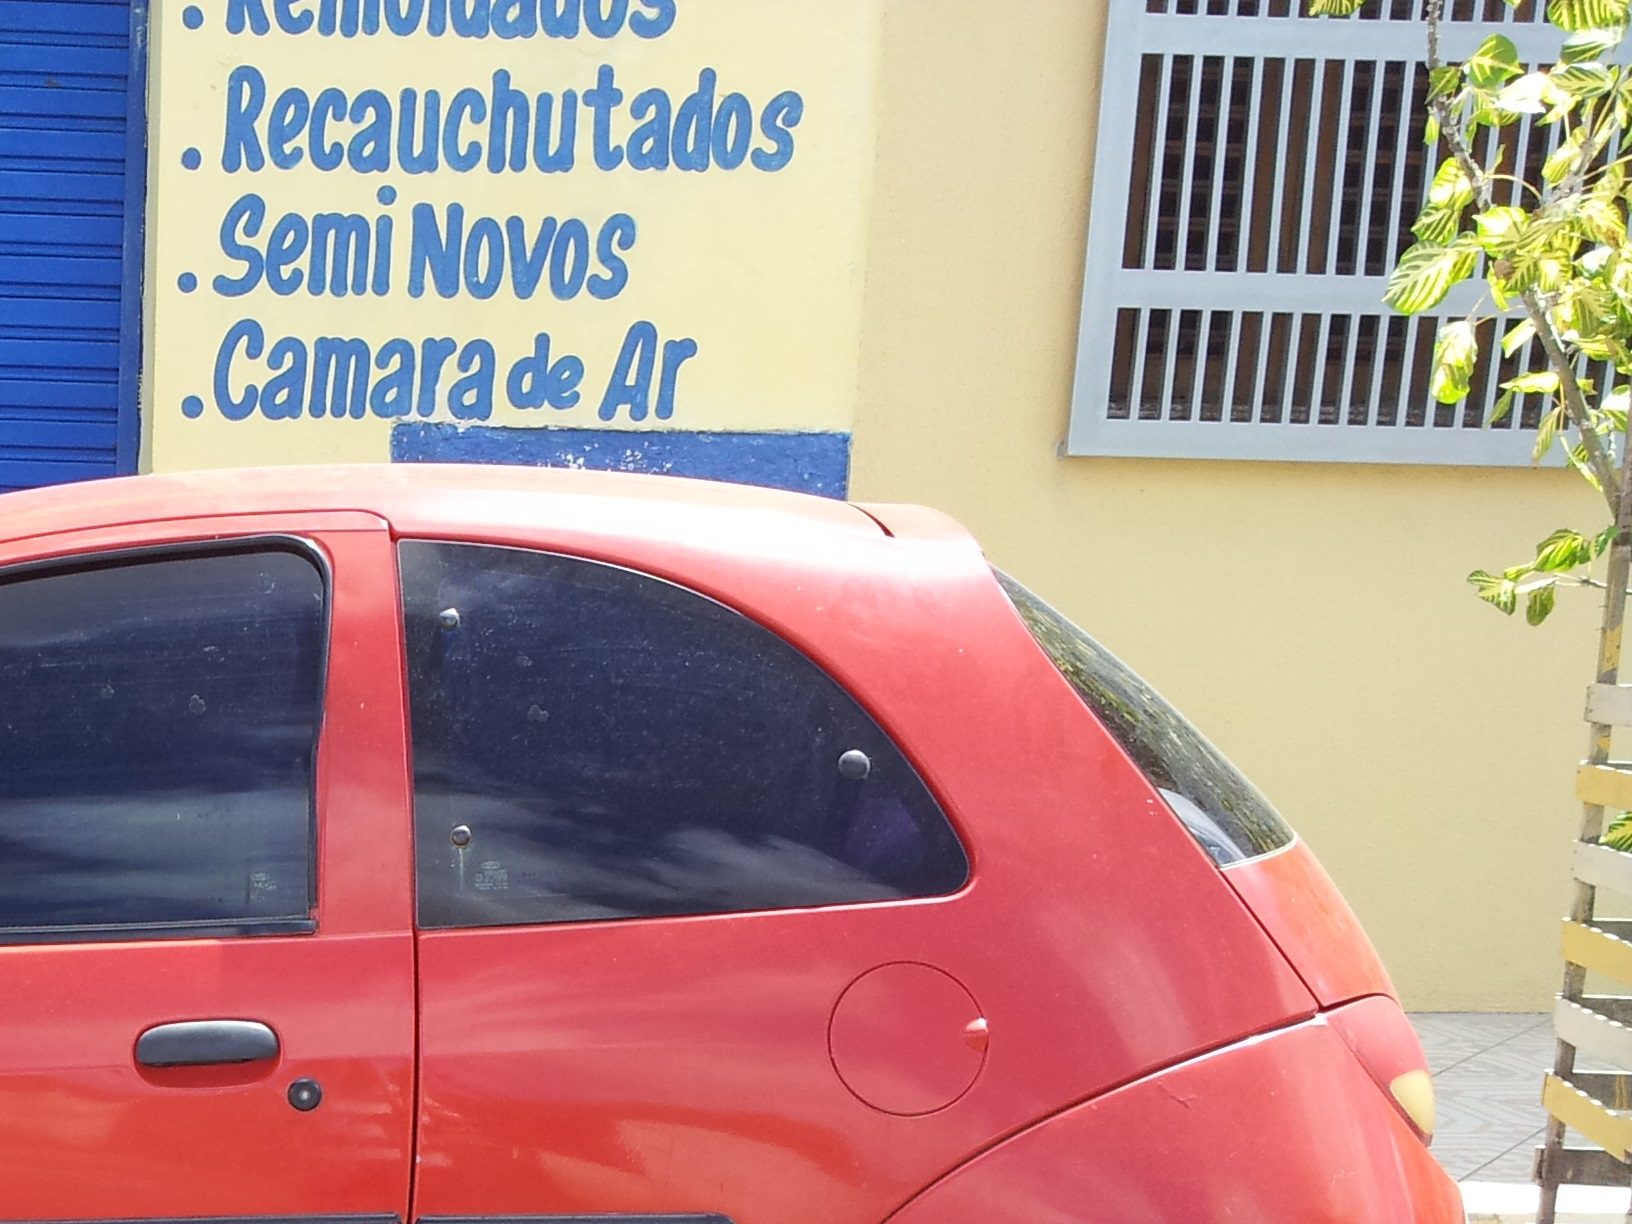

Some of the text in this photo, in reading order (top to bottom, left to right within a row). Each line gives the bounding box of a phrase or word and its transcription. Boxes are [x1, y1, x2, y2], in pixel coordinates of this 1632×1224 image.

[221, 64, 804, 174] Recauchutados
[212, 186, 637, 300] Semi Novos
[213, 318, 699, 422] Camara de Ar
